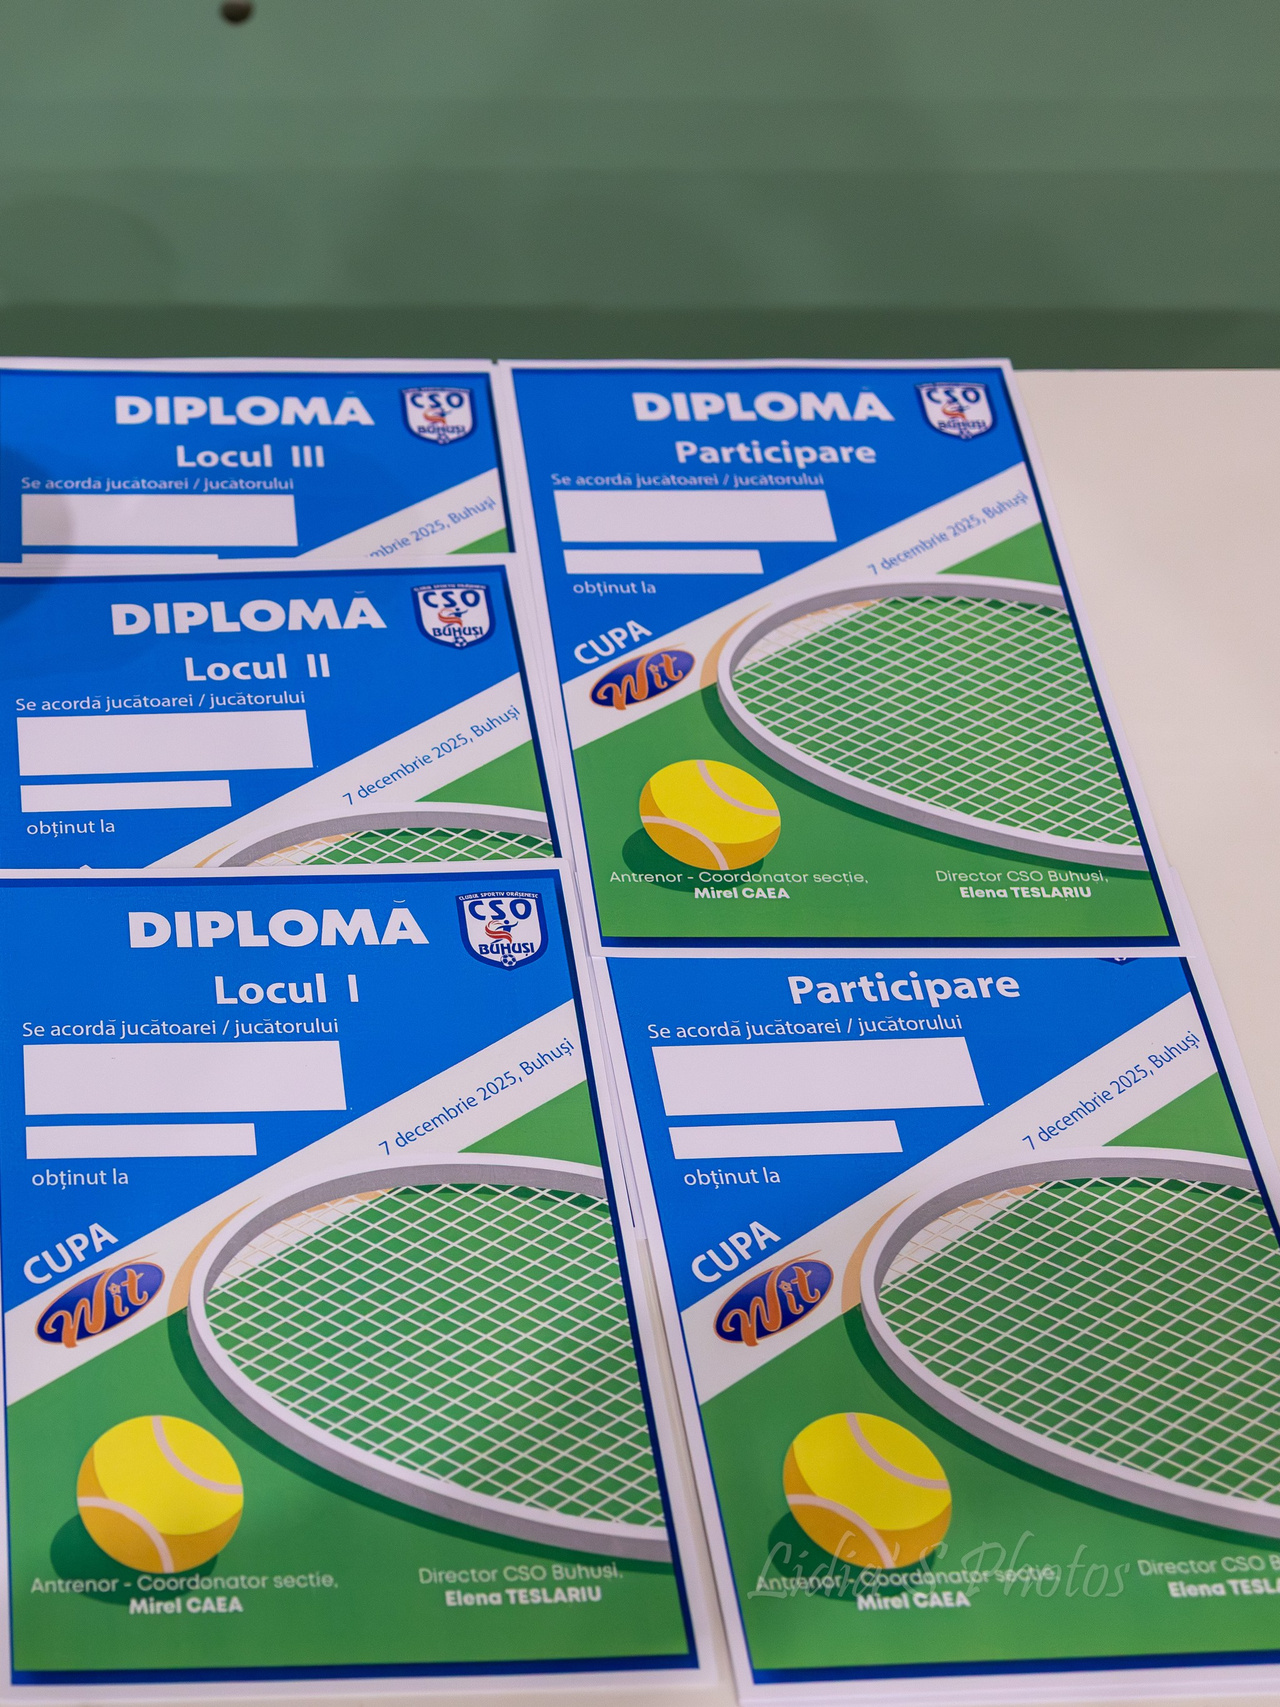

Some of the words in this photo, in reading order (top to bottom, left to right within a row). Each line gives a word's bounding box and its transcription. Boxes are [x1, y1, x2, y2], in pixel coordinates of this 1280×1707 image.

[411, 393, 464, 408] CSO
[926, 387, 980, 403] CSO
[176, 444, 272, 468] Locul
[292, 445, 325, 468] III
[675, 440, 877, 469] Participare
[21, 477, 41, 490] Se
[551, 474, 572, 486] Se
[369, 535, 412, 558] mbrie
[867, 563, 878, 576] 7
[880, 530, 950, 573] decembrie
[641, 580, 657, 595] la
[423, 590, 481, 609] CSO
[573, 620, 653, 665] CUPA
[185, 654, 287, 682] Locul
[307, 653, 331, 678] II
[15, 697, 39, 712] Se
[43, 694, 102, 711] acordă
[105, 693, 194, 713] jucătoarei
[209, 690, 306, 710] jucătorului
[342, 791, 355, 806] 7
[357, 754, 434, 799] decembrie
[430, 732, 474, 760] 2025,
[469, 704, 521, 740] Buhuși
[26, 819, 95, 838] obținut
[98, 819, 115, 834] la
[609, 871, 683, 884] Antrenor
[698, 871, 809, 884] Coordonator
[935, 870, 1003, 883] Director
[1006, 870, 1044, 883] CSO
[694, 887, 739, 900] Mirel
[741, 887, 791, 900] CAEA
[959, 886, 1009, 899] Elena
[1010, 886, 1093, 899] TESLARIU
[468, 898, 532, 920] CSO
[128, 900, 429, 949] DIPLOMĂ
[214, 973, 326, 1005] Locul
[347, 974, 359, 1003] I
[786, 970, 1021, 1008] Participare
[22, 1021, 46, 1037] Se
[50, 1018, 116, 1037] acordă
[120, 1018, 217, 1040] jucătoarei
[233, 1016, 339, 1038] jucătorului
[647, 1023, 671, 1039] Se
[675, 1019, 742, 1039] acordă
[745, 1017, 841, 1041] jucătoarei
[858, 1014, 962, 1038] jucătorului
[378, 1140, 392, 1157] 7
[394, 1093, 480, 1150] decembrie
[475, 1068, 525, 1101] 2025,
[518, 1036, 575, 1078] Buhuși
[1021, 1134, 1037, 1151] 7
[1037, 1086, 1114, 1145] decembrie
[1110, 1062, 1153, 1094] 2025,
[1147, 1030, 1202, 1071] Buhuși
[31, 1168, 107, 1191] obținut
[111, 1168, 129, 1186] la
[683, 1167, 759, 1191] obținut
[763, 1167, 781, 1184] la
[23, 1222, 119, 1285] CUPA
[690, 1221, 782, 1284] CUPA
[418, 1567, 498, 1585] Director
[503, 1565, 547, 1582] CSO
[1137, 1559, 1218, 1576] Director
[1221, 1555, 1266, 1573] CSO
[31, 1576, 120, 1594] Antrenor
[136, 1574, 270, 1591] Coordonator
[755, 1575, 843, 1592] Antrenor
[859, 1568, 990, 1587] Coordonator
[1167, 1580, 1227, 1598] Elena
[129, 1597, 183, 1615] Mirel
[186, 1596, 244, 1614] CAEA
[445, 1589, 503, 1607] Elena
[505, 1586, 603, 1605] TESLARIU
[856, 1592, 910, 1611] Mirel
[912, 1590, 971, 1608] CAEA
